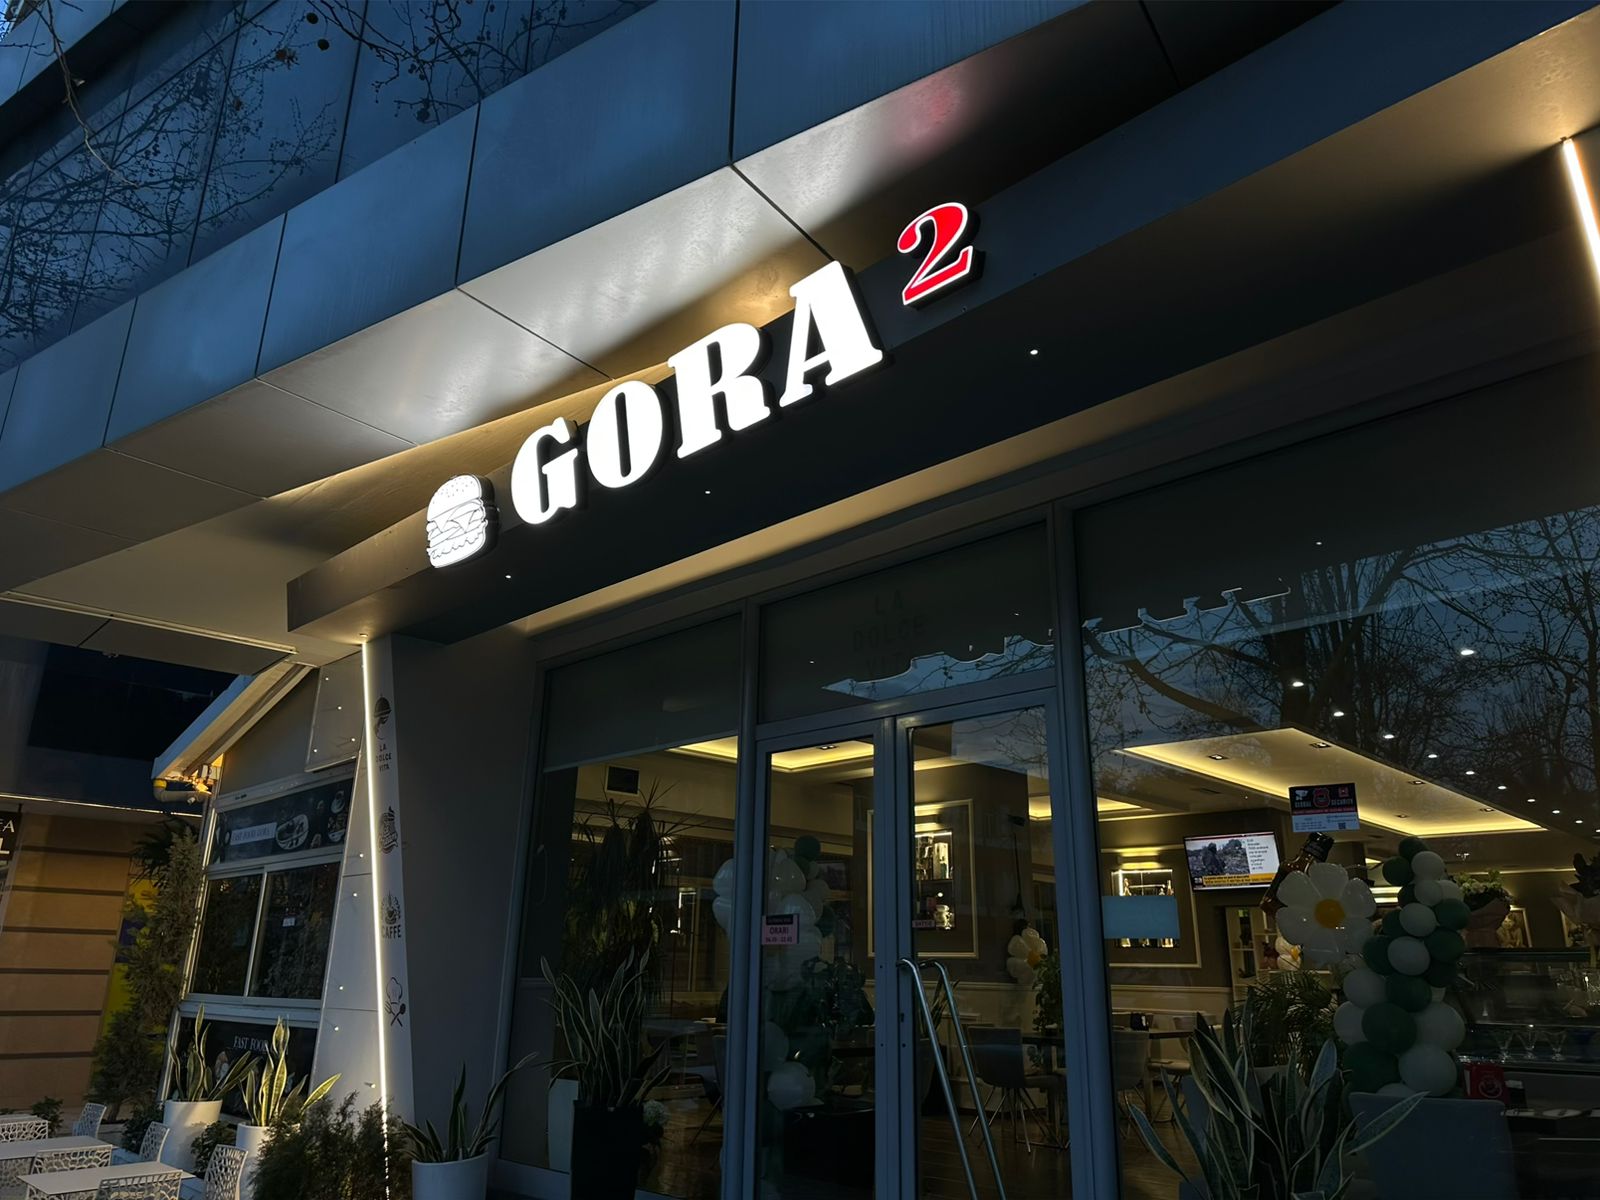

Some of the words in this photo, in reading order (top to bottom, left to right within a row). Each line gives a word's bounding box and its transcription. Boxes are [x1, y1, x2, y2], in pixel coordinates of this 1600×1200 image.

[510, 259, 884, 526] GORA
[896, 201, 976, 307] 2
[381, 924, 402, 940] CAFFE
[233, 1035, 250, 1050] FAST
